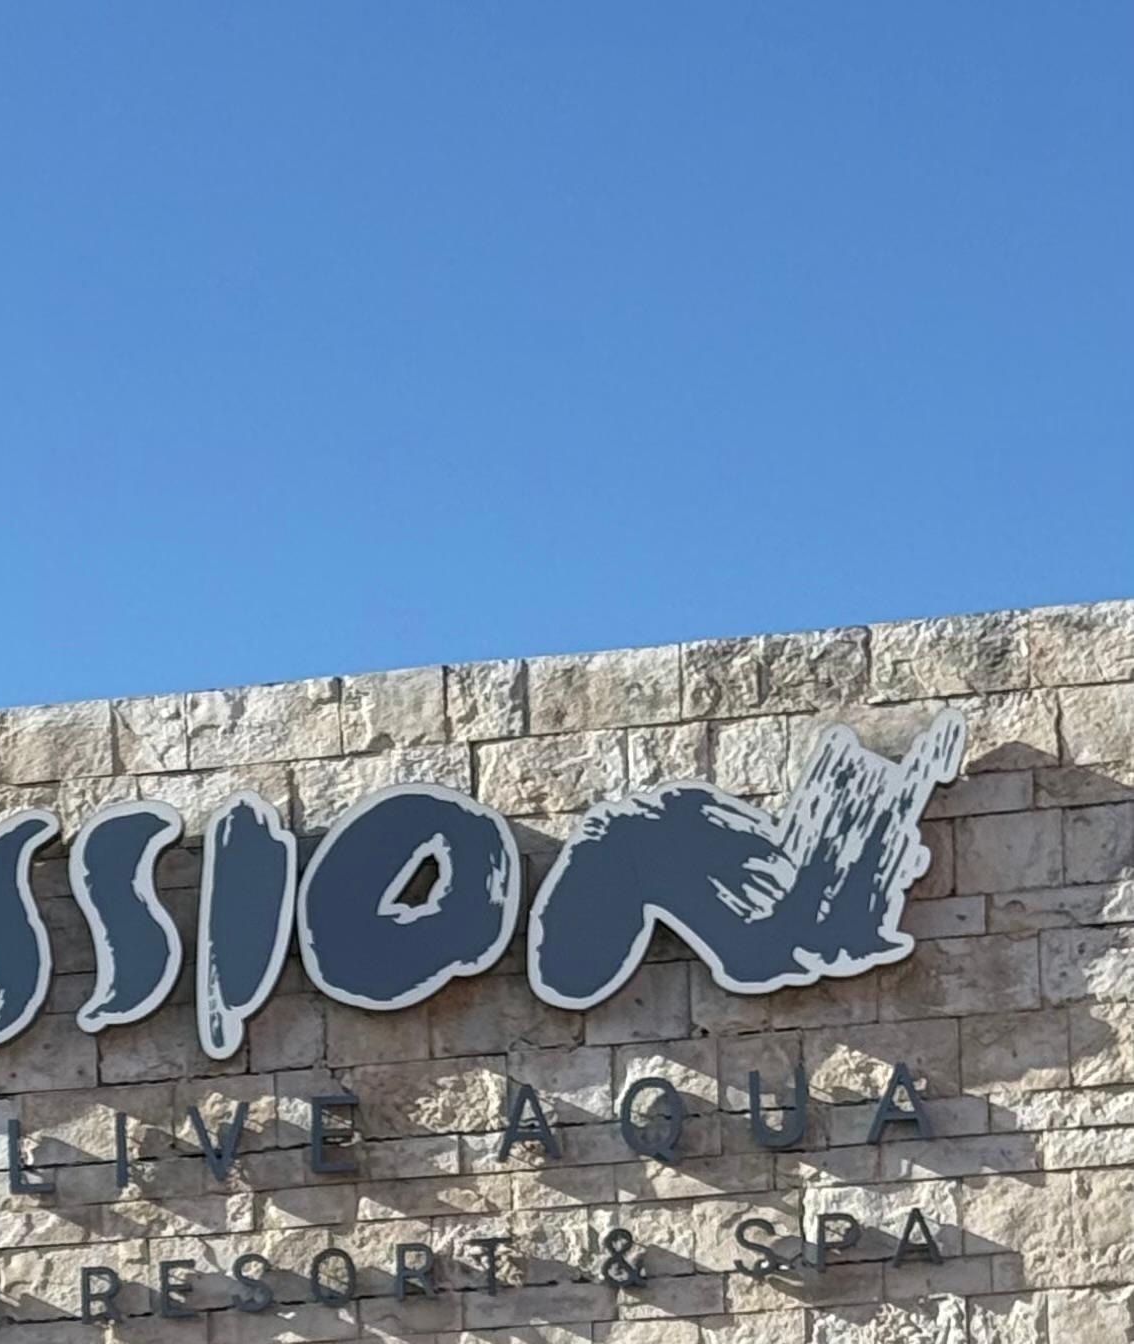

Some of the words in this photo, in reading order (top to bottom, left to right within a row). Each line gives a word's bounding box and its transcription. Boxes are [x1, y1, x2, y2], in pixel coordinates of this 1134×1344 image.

[8, 1093, 360, 1196] LIVE
[498, 1061, 936, 1167] AQUA
[80, 1236, 513, 1326] RESORT
[600, 1228, 648, 1289] &
[733, 1206, 944, 1278] SPA
